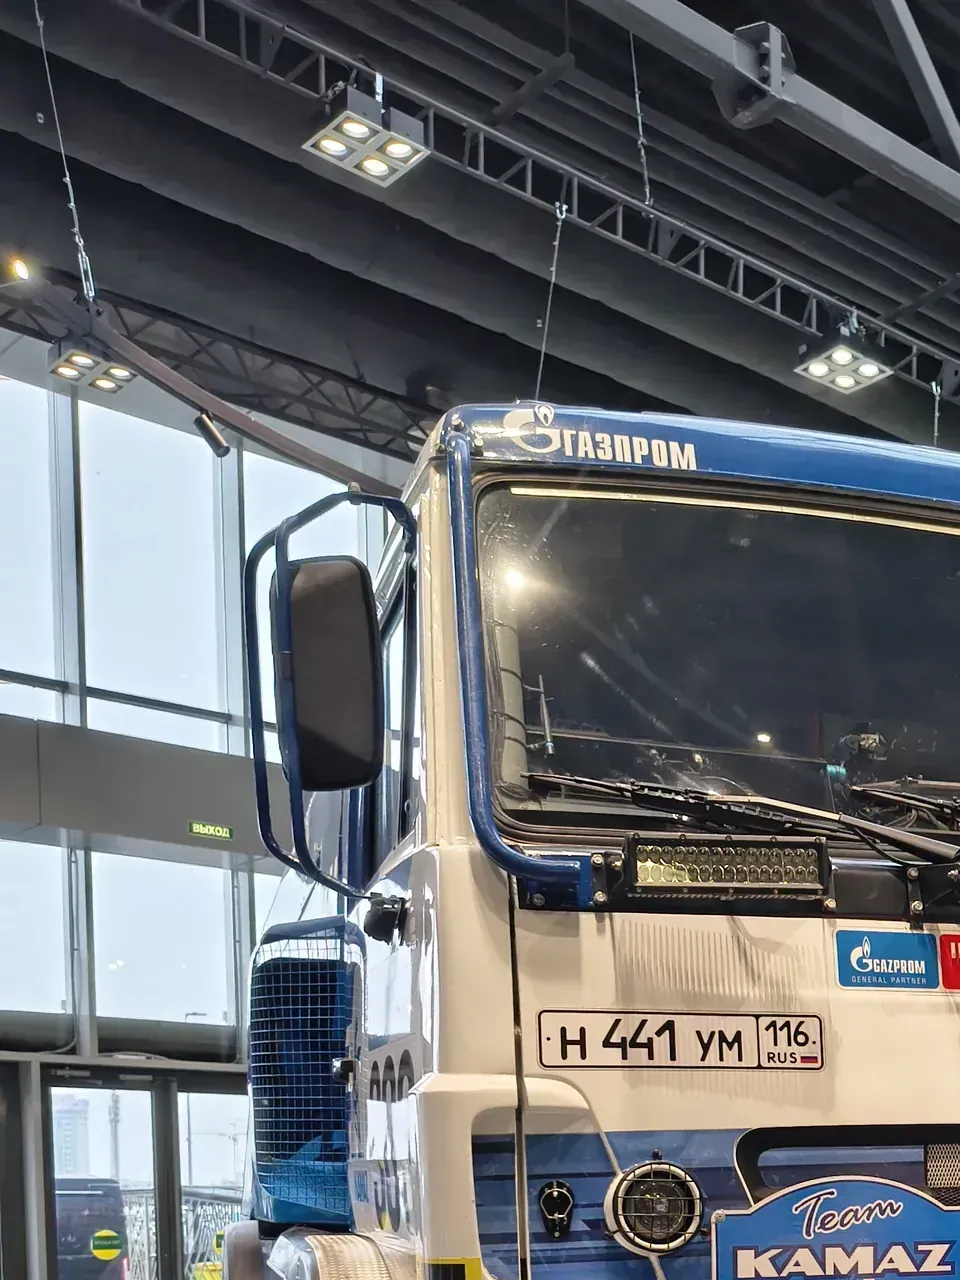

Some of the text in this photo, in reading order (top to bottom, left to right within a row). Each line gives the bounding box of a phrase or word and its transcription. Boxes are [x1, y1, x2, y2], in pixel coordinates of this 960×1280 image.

[192, 823, 231, 838] ВЫХОД
[851, 975, 927, 986] GENERAL PARTNER
[602, 1018, 677, 1062] 441
[764, 1020, 810, 1048] 116
[766, 1052, 798, 1064] RUS
[792, 1187, 904, 1240] Team
[735, 1242, 954, 1280] KAMAZ
